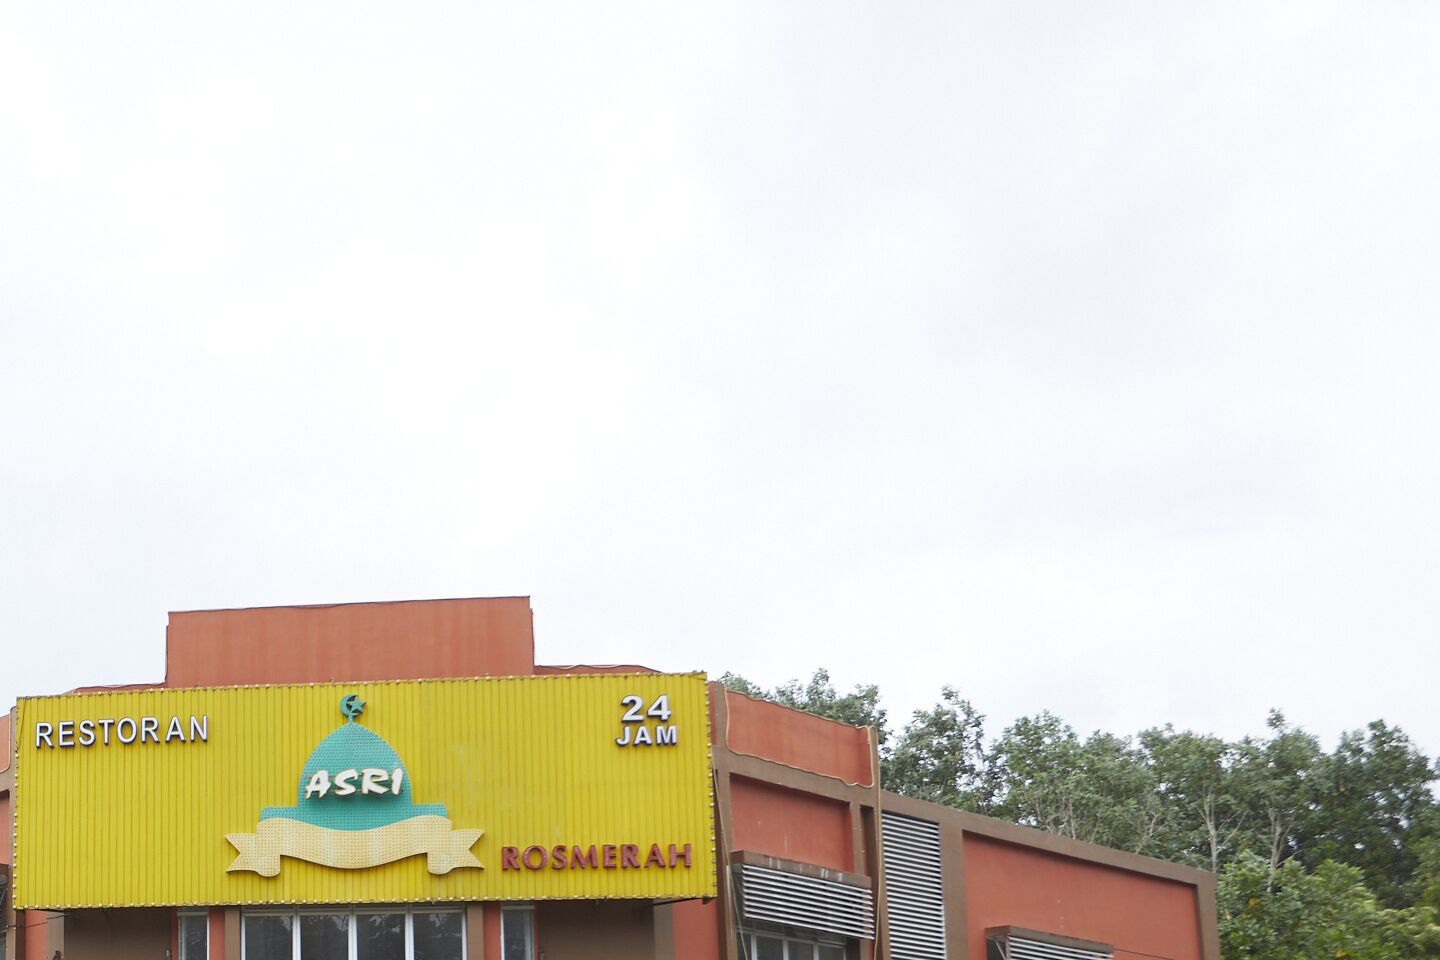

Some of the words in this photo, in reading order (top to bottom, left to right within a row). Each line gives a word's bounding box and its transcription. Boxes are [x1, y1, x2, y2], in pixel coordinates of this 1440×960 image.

[620, 694, 673, 723] 24
[35, 714, 209, 748] RESTORAN
[615, 725, 679, 747] JAM
[305, 767, 405, 800] ASRI
[500, 843, 693, 872] ROSMERAH
